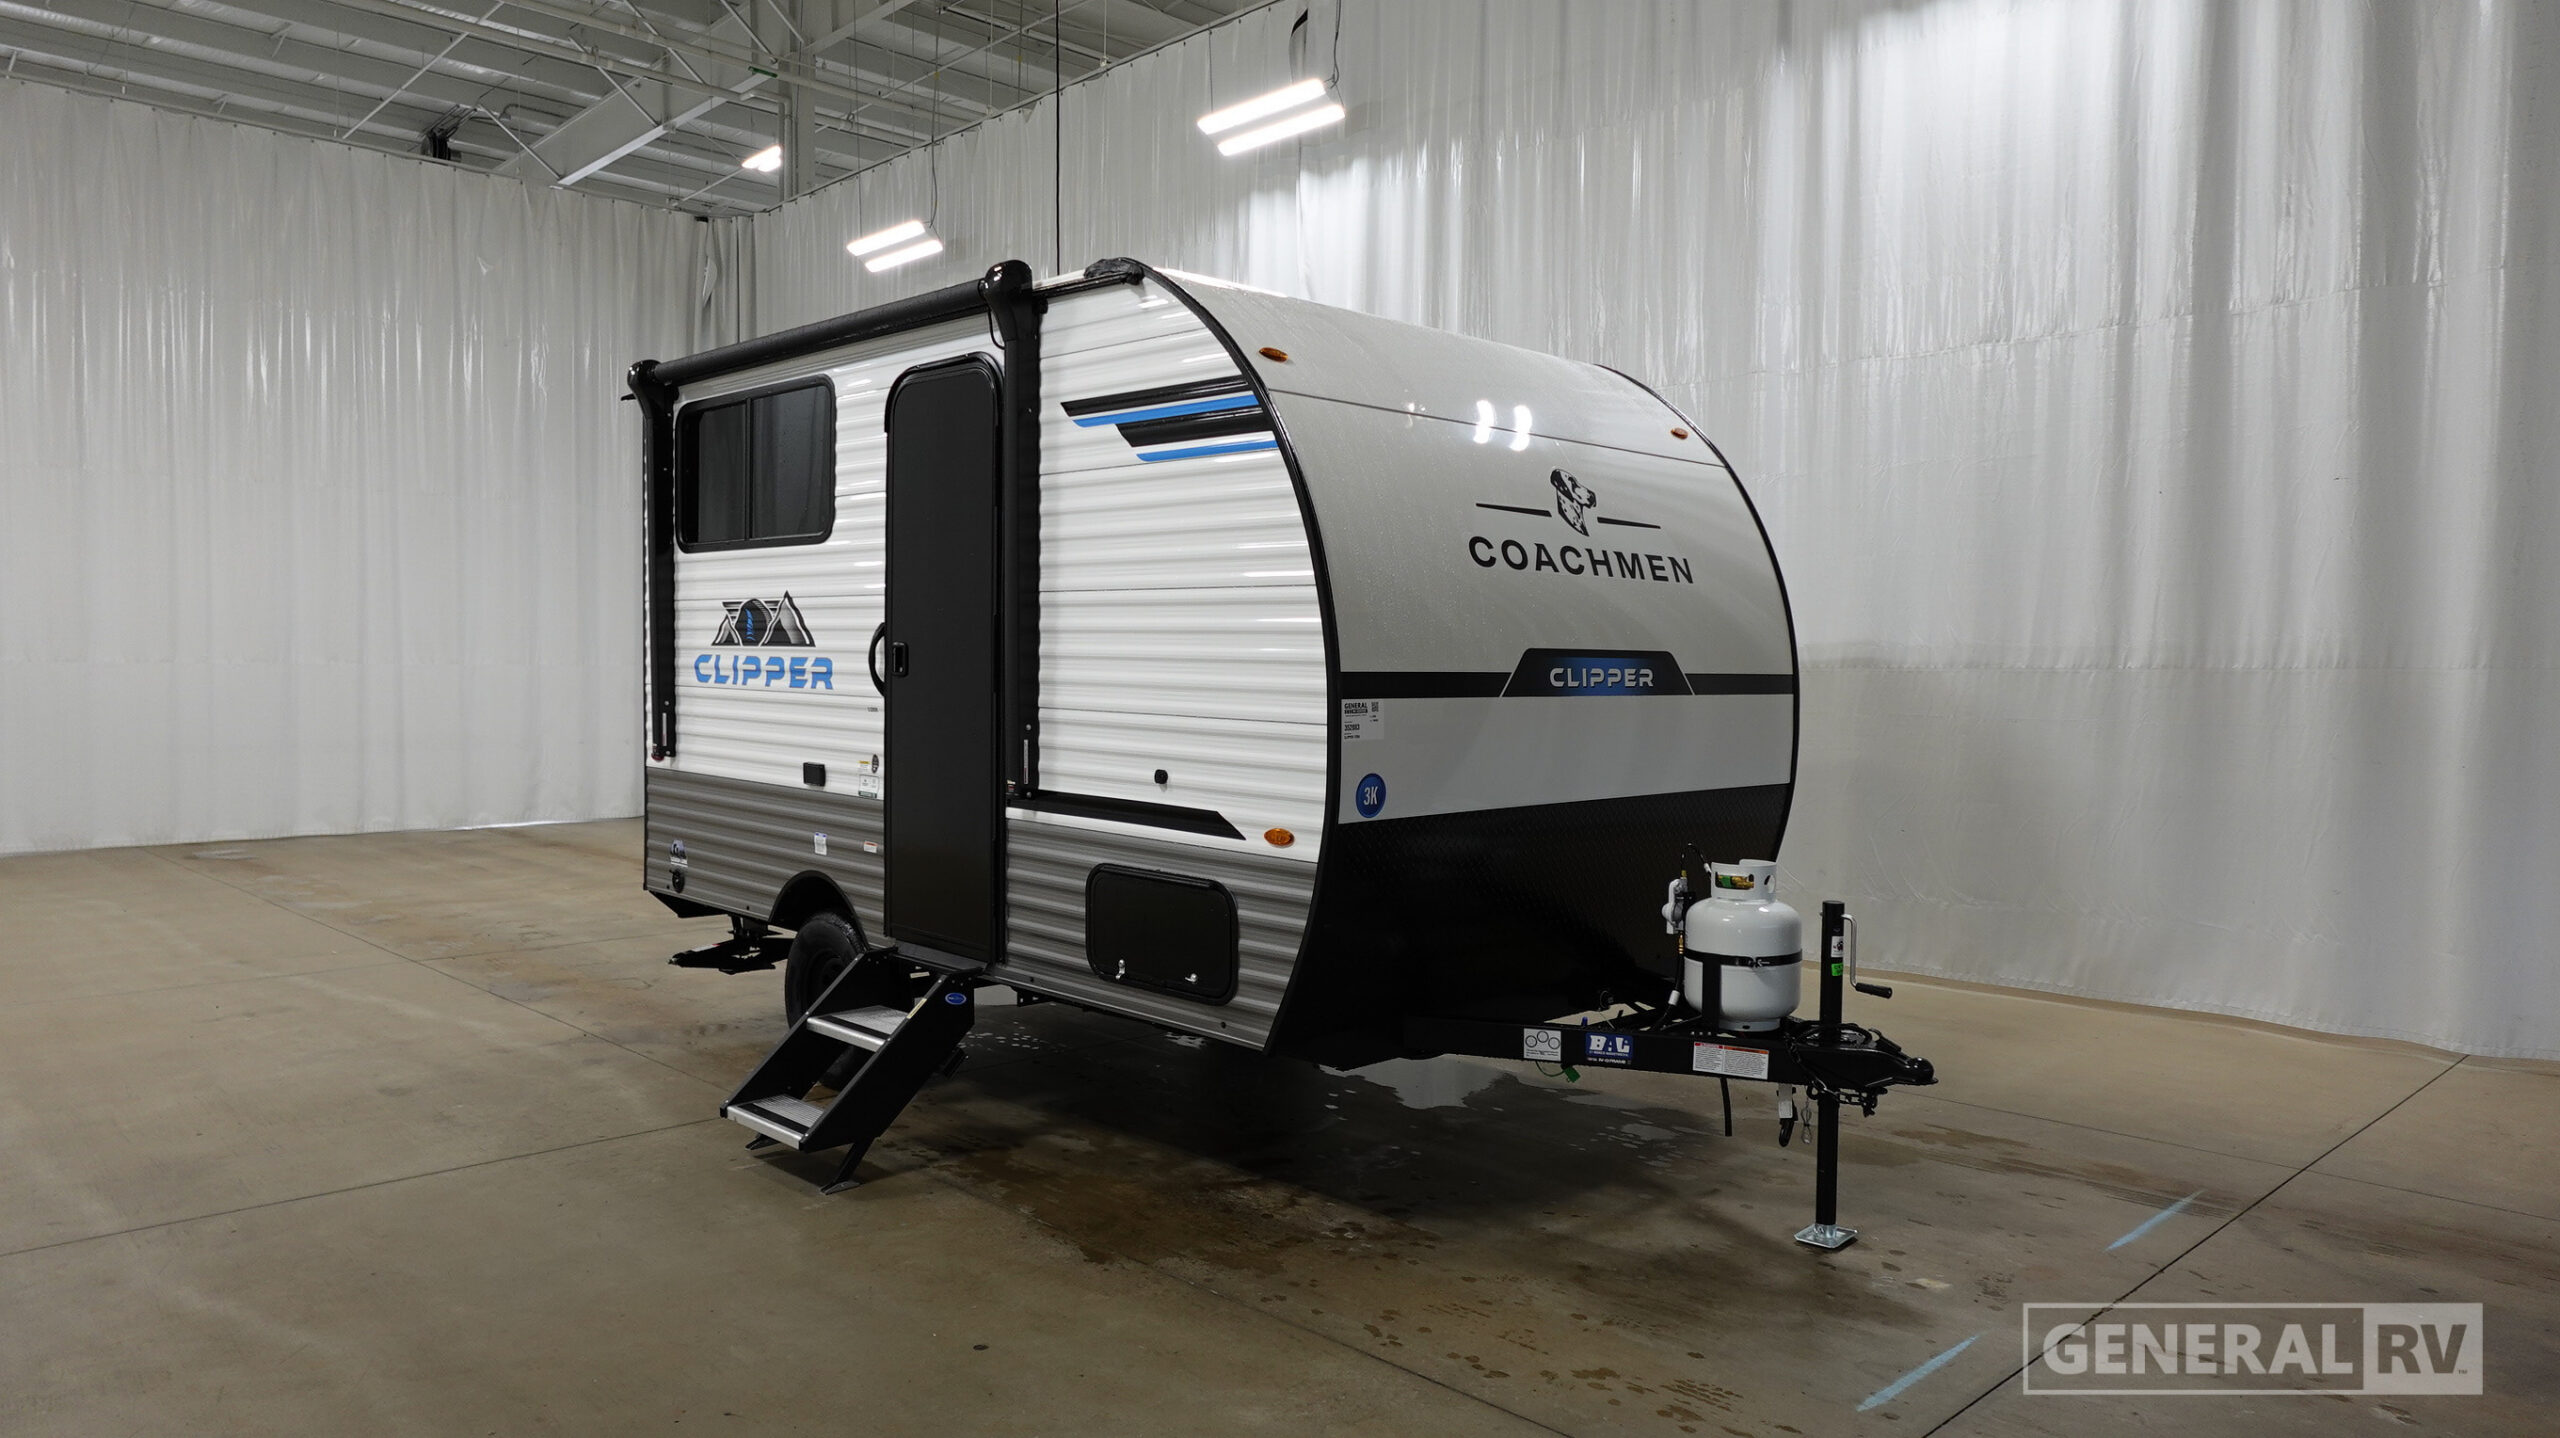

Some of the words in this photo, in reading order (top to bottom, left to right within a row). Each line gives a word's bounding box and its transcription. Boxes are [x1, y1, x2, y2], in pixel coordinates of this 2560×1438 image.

[1468, 536, 1695, 584] COACHMEN
[694, 654, 834, 690] CLIPPER
[1549, 667, 1655, 687] CLIPPER
[1363, 786, 1378, 806] 3K
[1590, 1035, 1630, 1053] BAL
